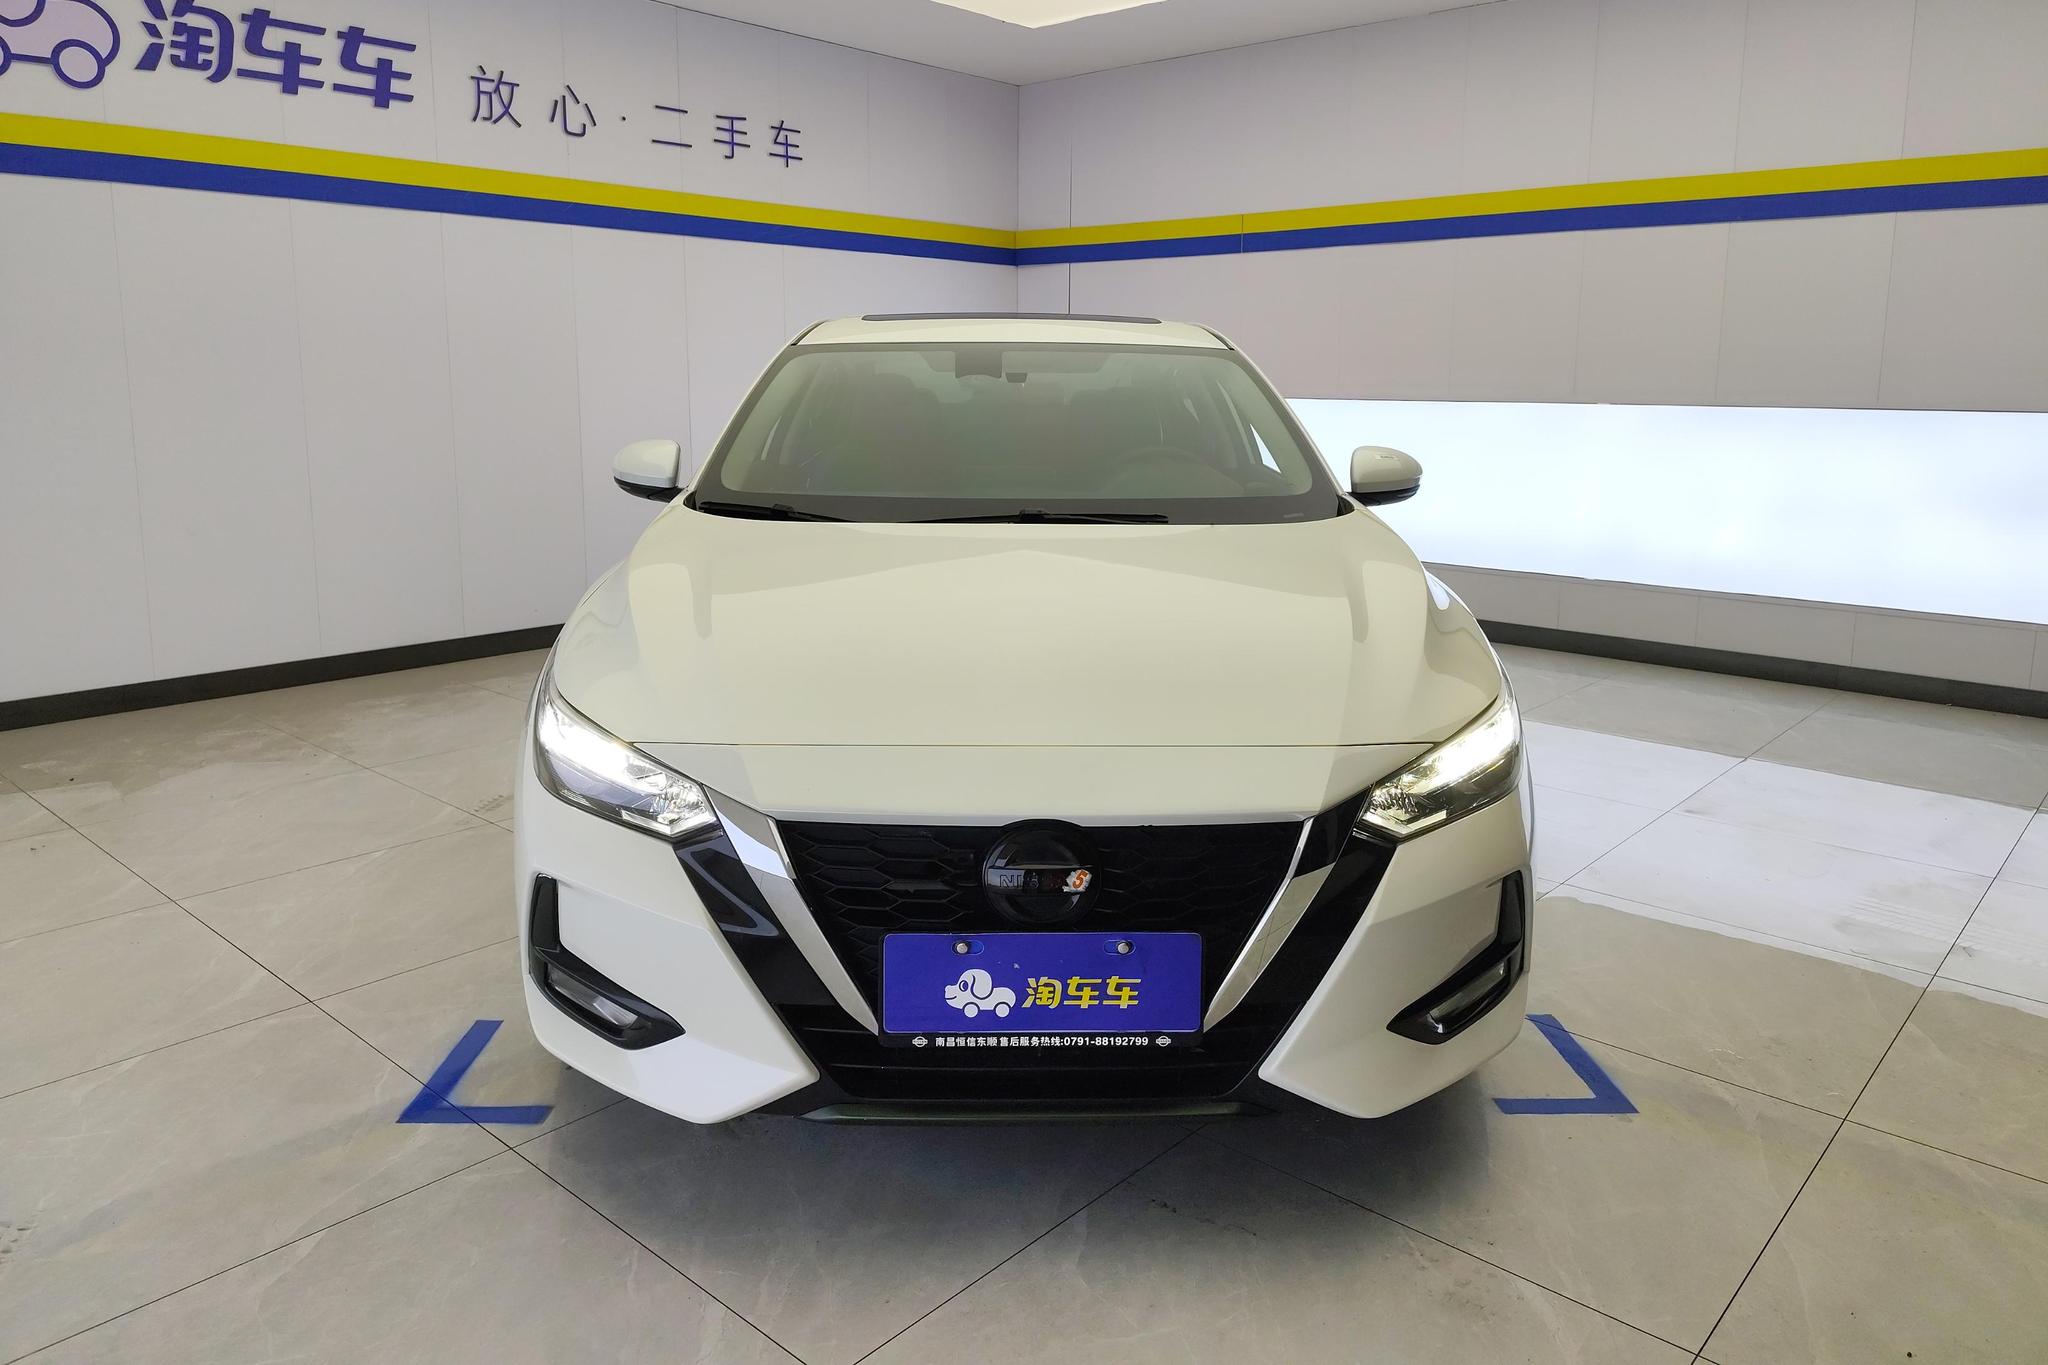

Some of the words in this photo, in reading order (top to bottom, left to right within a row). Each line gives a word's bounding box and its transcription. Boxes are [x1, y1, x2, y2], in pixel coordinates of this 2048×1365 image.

[134, 0, 417, 109] 淘车车
[1021, 976, 1142, 1009] 淘车车
